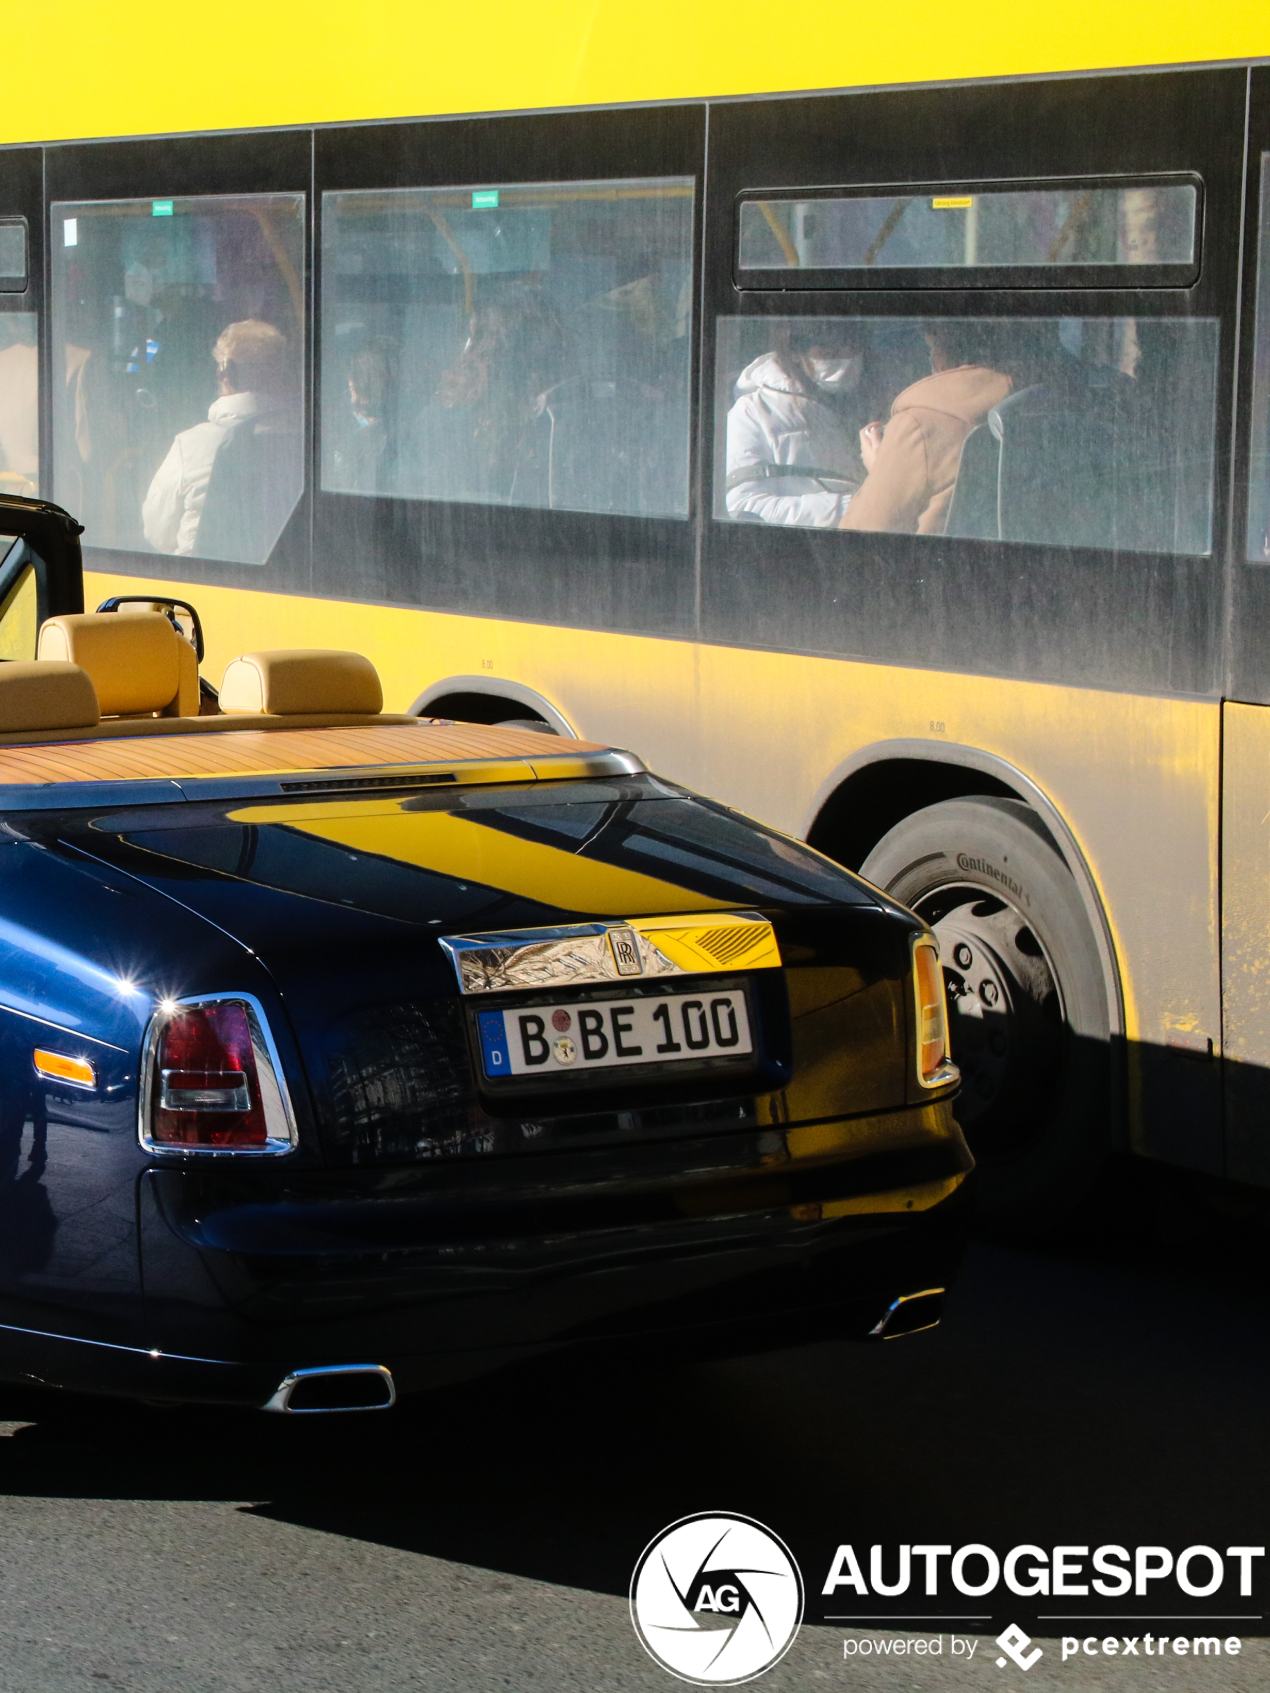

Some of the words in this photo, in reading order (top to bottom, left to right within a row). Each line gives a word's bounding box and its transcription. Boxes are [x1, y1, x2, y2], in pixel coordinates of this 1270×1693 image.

[956, 852, 1023, 899] Continental
[518, 1014, 550, 1067] B
[577, 1005, 643, 1061] BE
[652, 997, 740, 1055] 100
[491, 1050, 503, 1066] D
